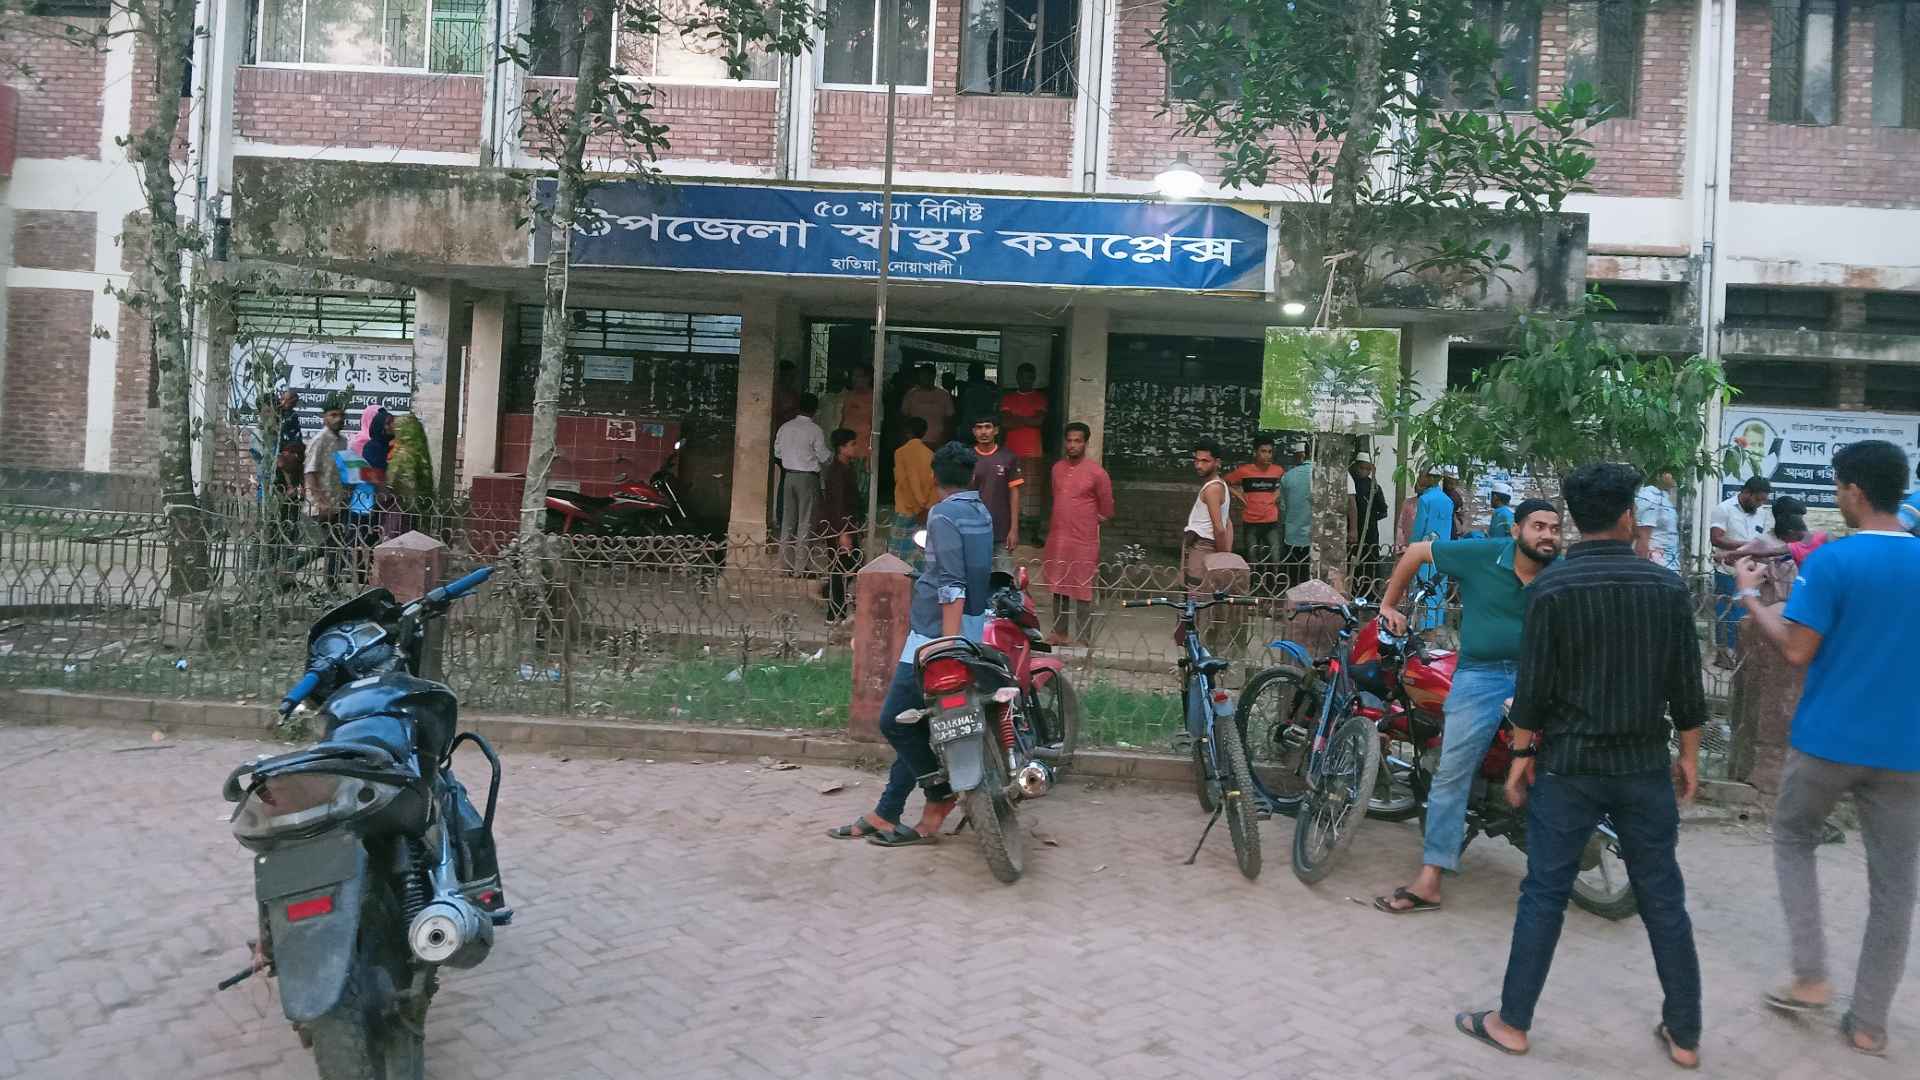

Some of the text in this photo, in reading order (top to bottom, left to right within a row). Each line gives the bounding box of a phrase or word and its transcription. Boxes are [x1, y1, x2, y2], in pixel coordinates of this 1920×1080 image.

[813, 200, 849, 218] ৫০
[917, 197, 985, 223] বিশিষ্ট
[573, 206, 1246, 267] উপজেলা স্বাস্থ্য কমপ্লেক্স
[1790, 440, 1826, 456] জনাব
